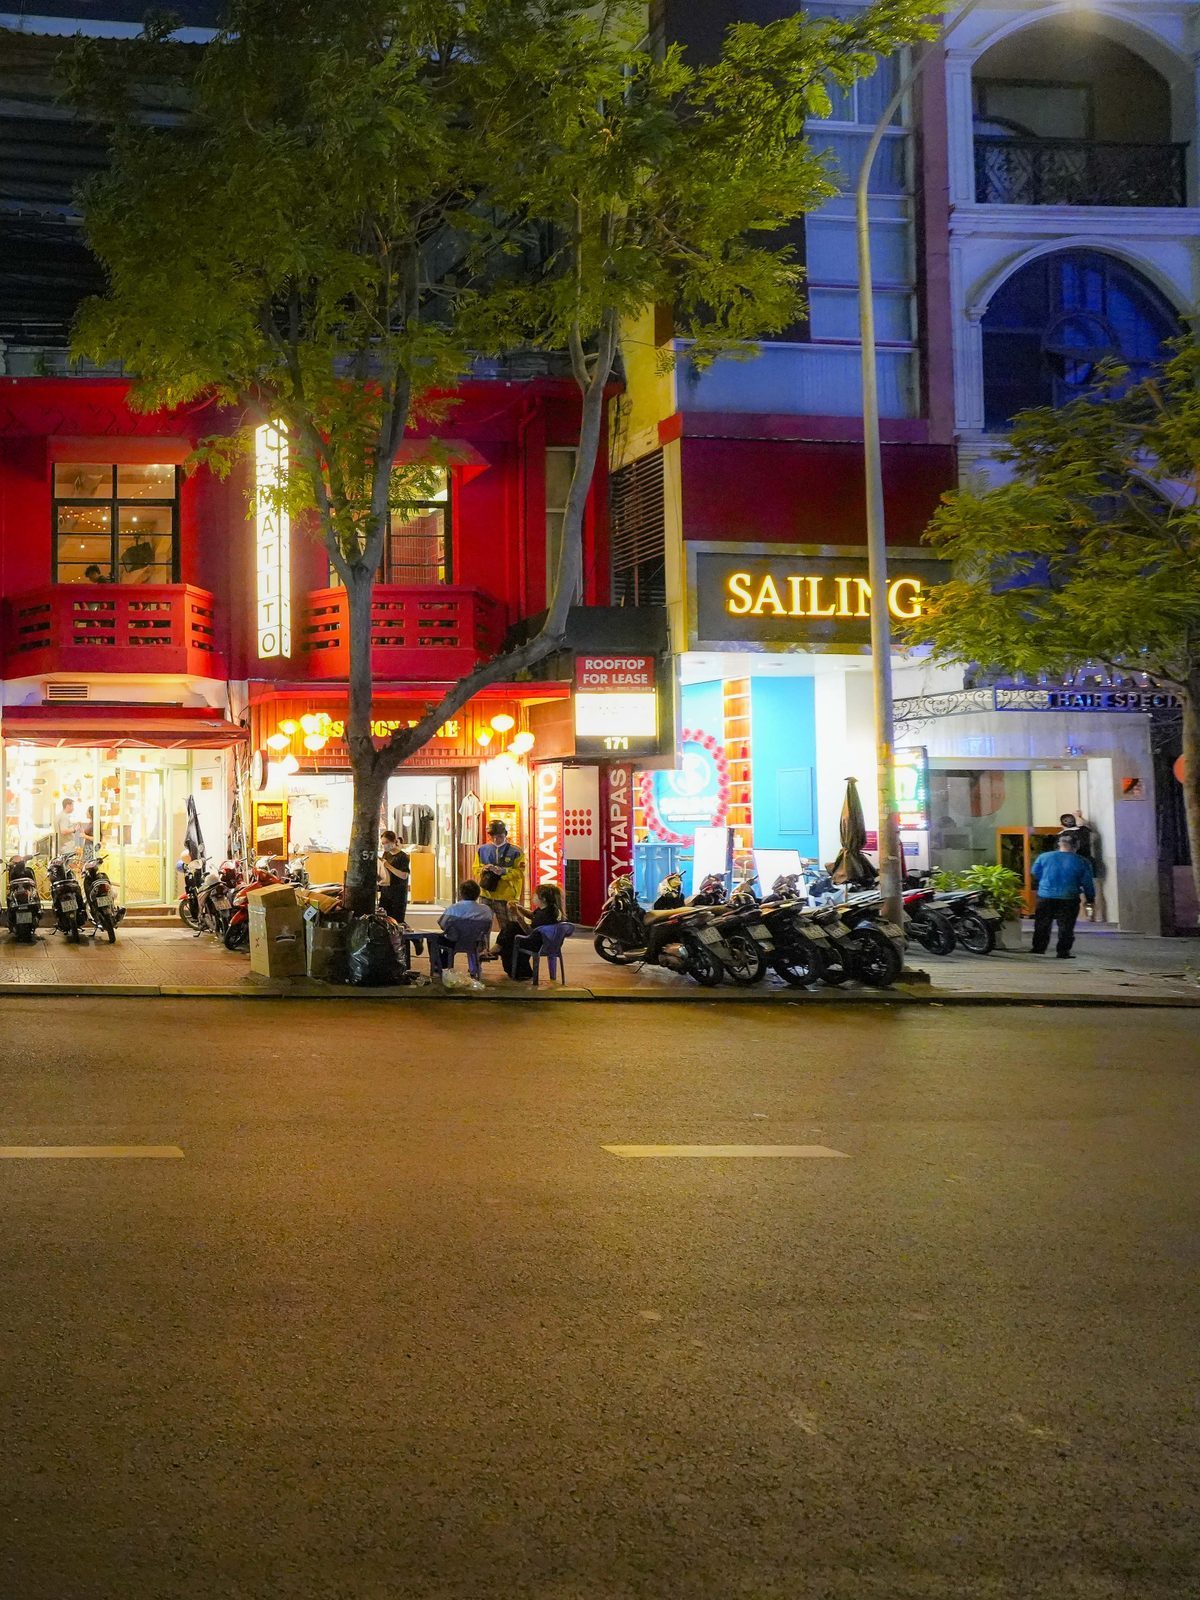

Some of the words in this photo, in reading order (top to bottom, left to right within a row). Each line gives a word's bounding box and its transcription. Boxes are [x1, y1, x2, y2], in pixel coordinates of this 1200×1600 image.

[585, 659, 646, 670] ROOFTOP
[583, 673, 609, 684] FOR
[612, 673, 648, 684] LEASE
[1057, 692, 1101, 708] HAIR
[603, 736, 629, 750] 171
[610, 768, 628, 853] TAPAS
[362, 850, 375, 860] 57
